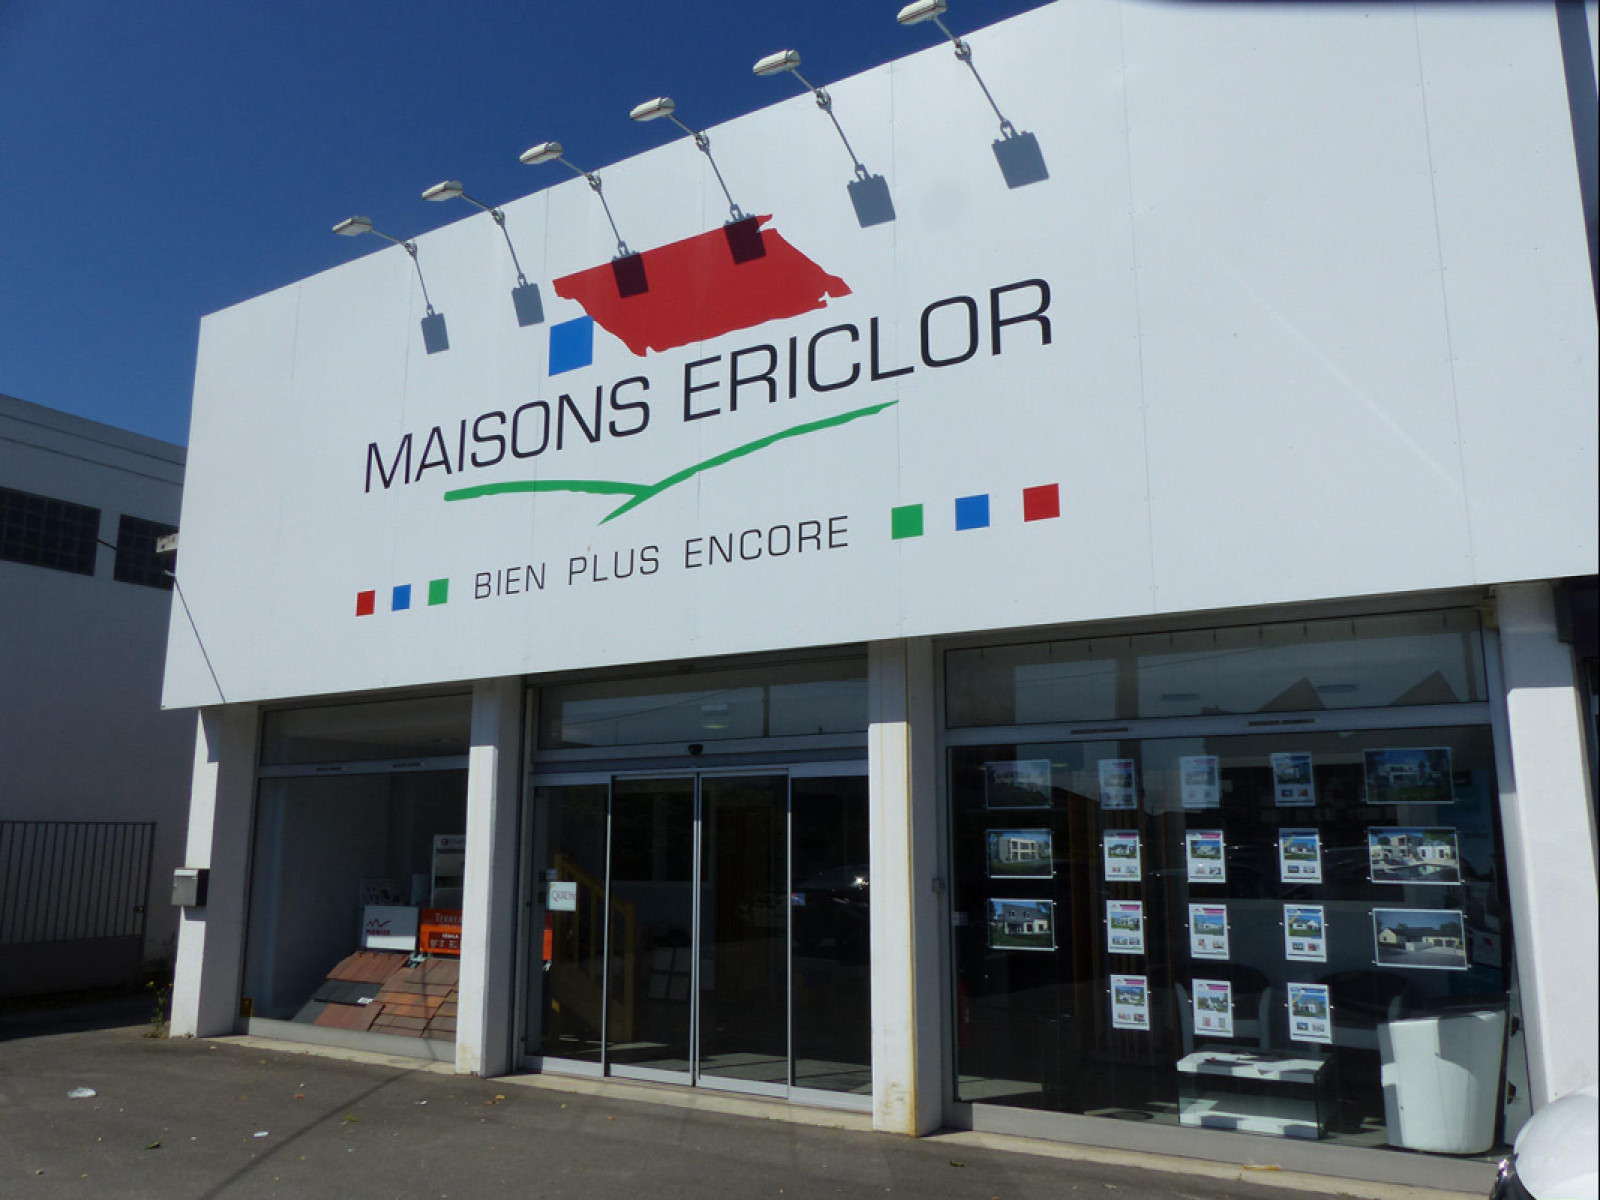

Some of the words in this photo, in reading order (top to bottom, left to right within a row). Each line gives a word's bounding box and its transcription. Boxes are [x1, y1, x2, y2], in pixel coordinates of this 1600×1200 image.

[365, 376, 650, 493] MAISONS
[683, 278, 1052, 422] ERICLOR
[474, 563, 545, 600] BIEN
[569, 545, 659, 586] PLUS
[684, 515, 848, 569] ENCORE
